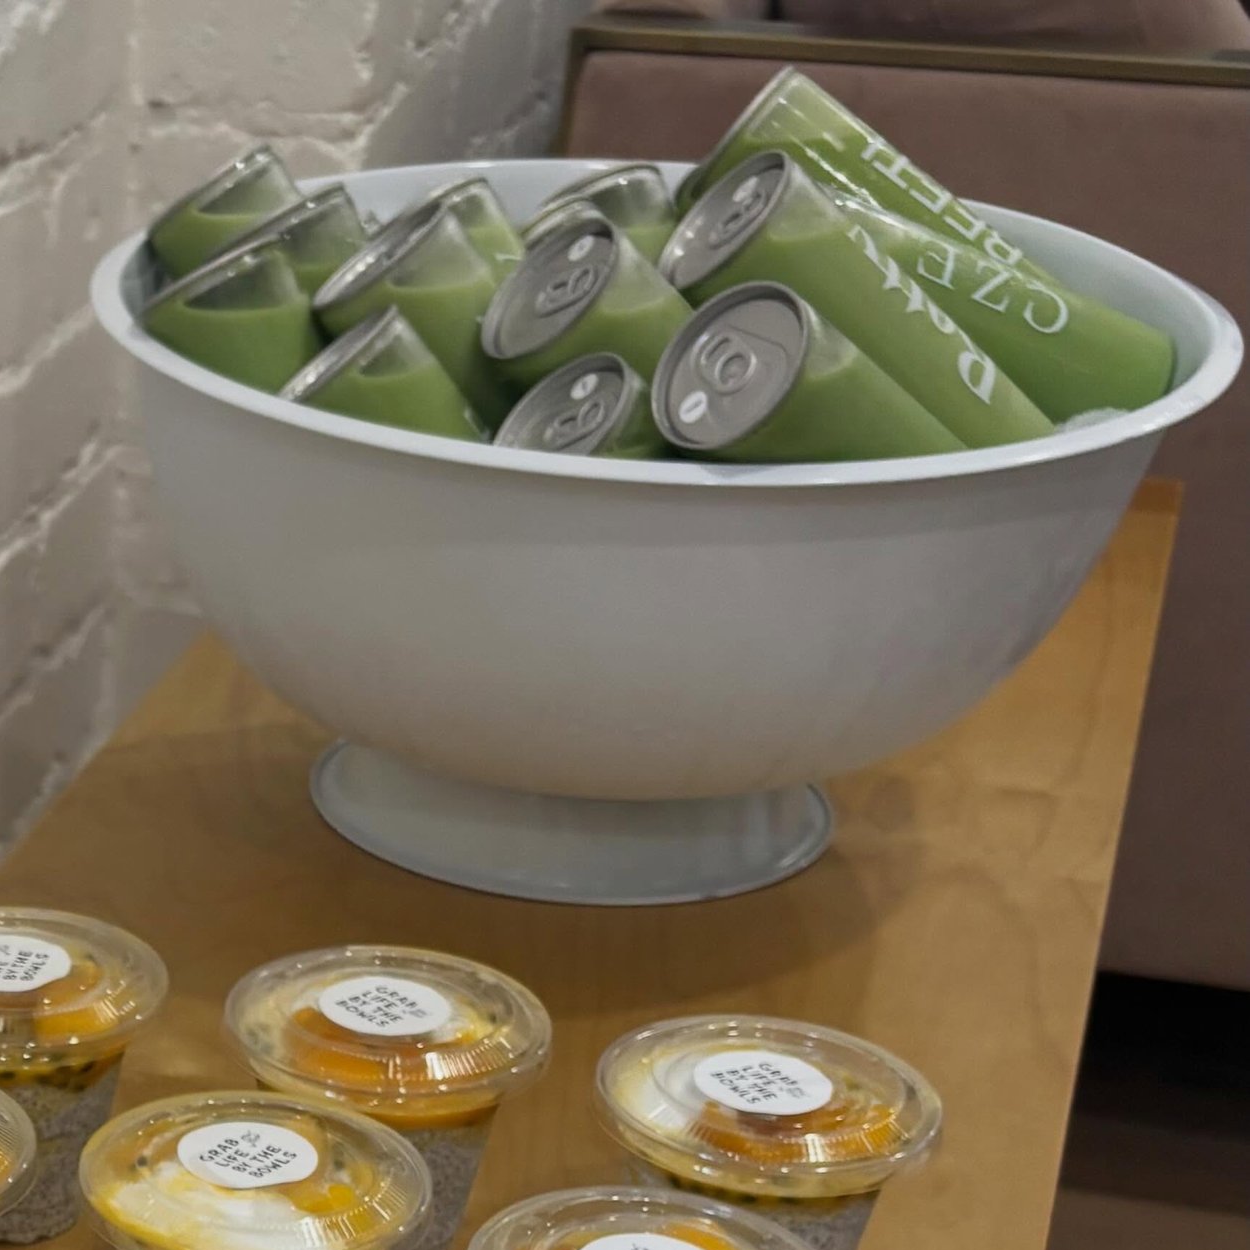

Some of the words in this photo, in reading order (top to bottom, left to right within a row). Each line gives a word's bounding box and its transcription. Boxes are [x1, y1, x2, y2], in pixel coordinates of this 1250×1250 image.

[3, 968, 18, 981] BY
[14, 951, 33, 969] THE
[20, 954, 50, 981] BOWLS
[199, 1138, 240, 1163] GRAB
[215, 1148, 249, 1167] LIFE
[232, 1160, 251, 1173] BY
[250, 1145, 282, 1164] THE
[249, 1152, 297, 1177] BOWLS
